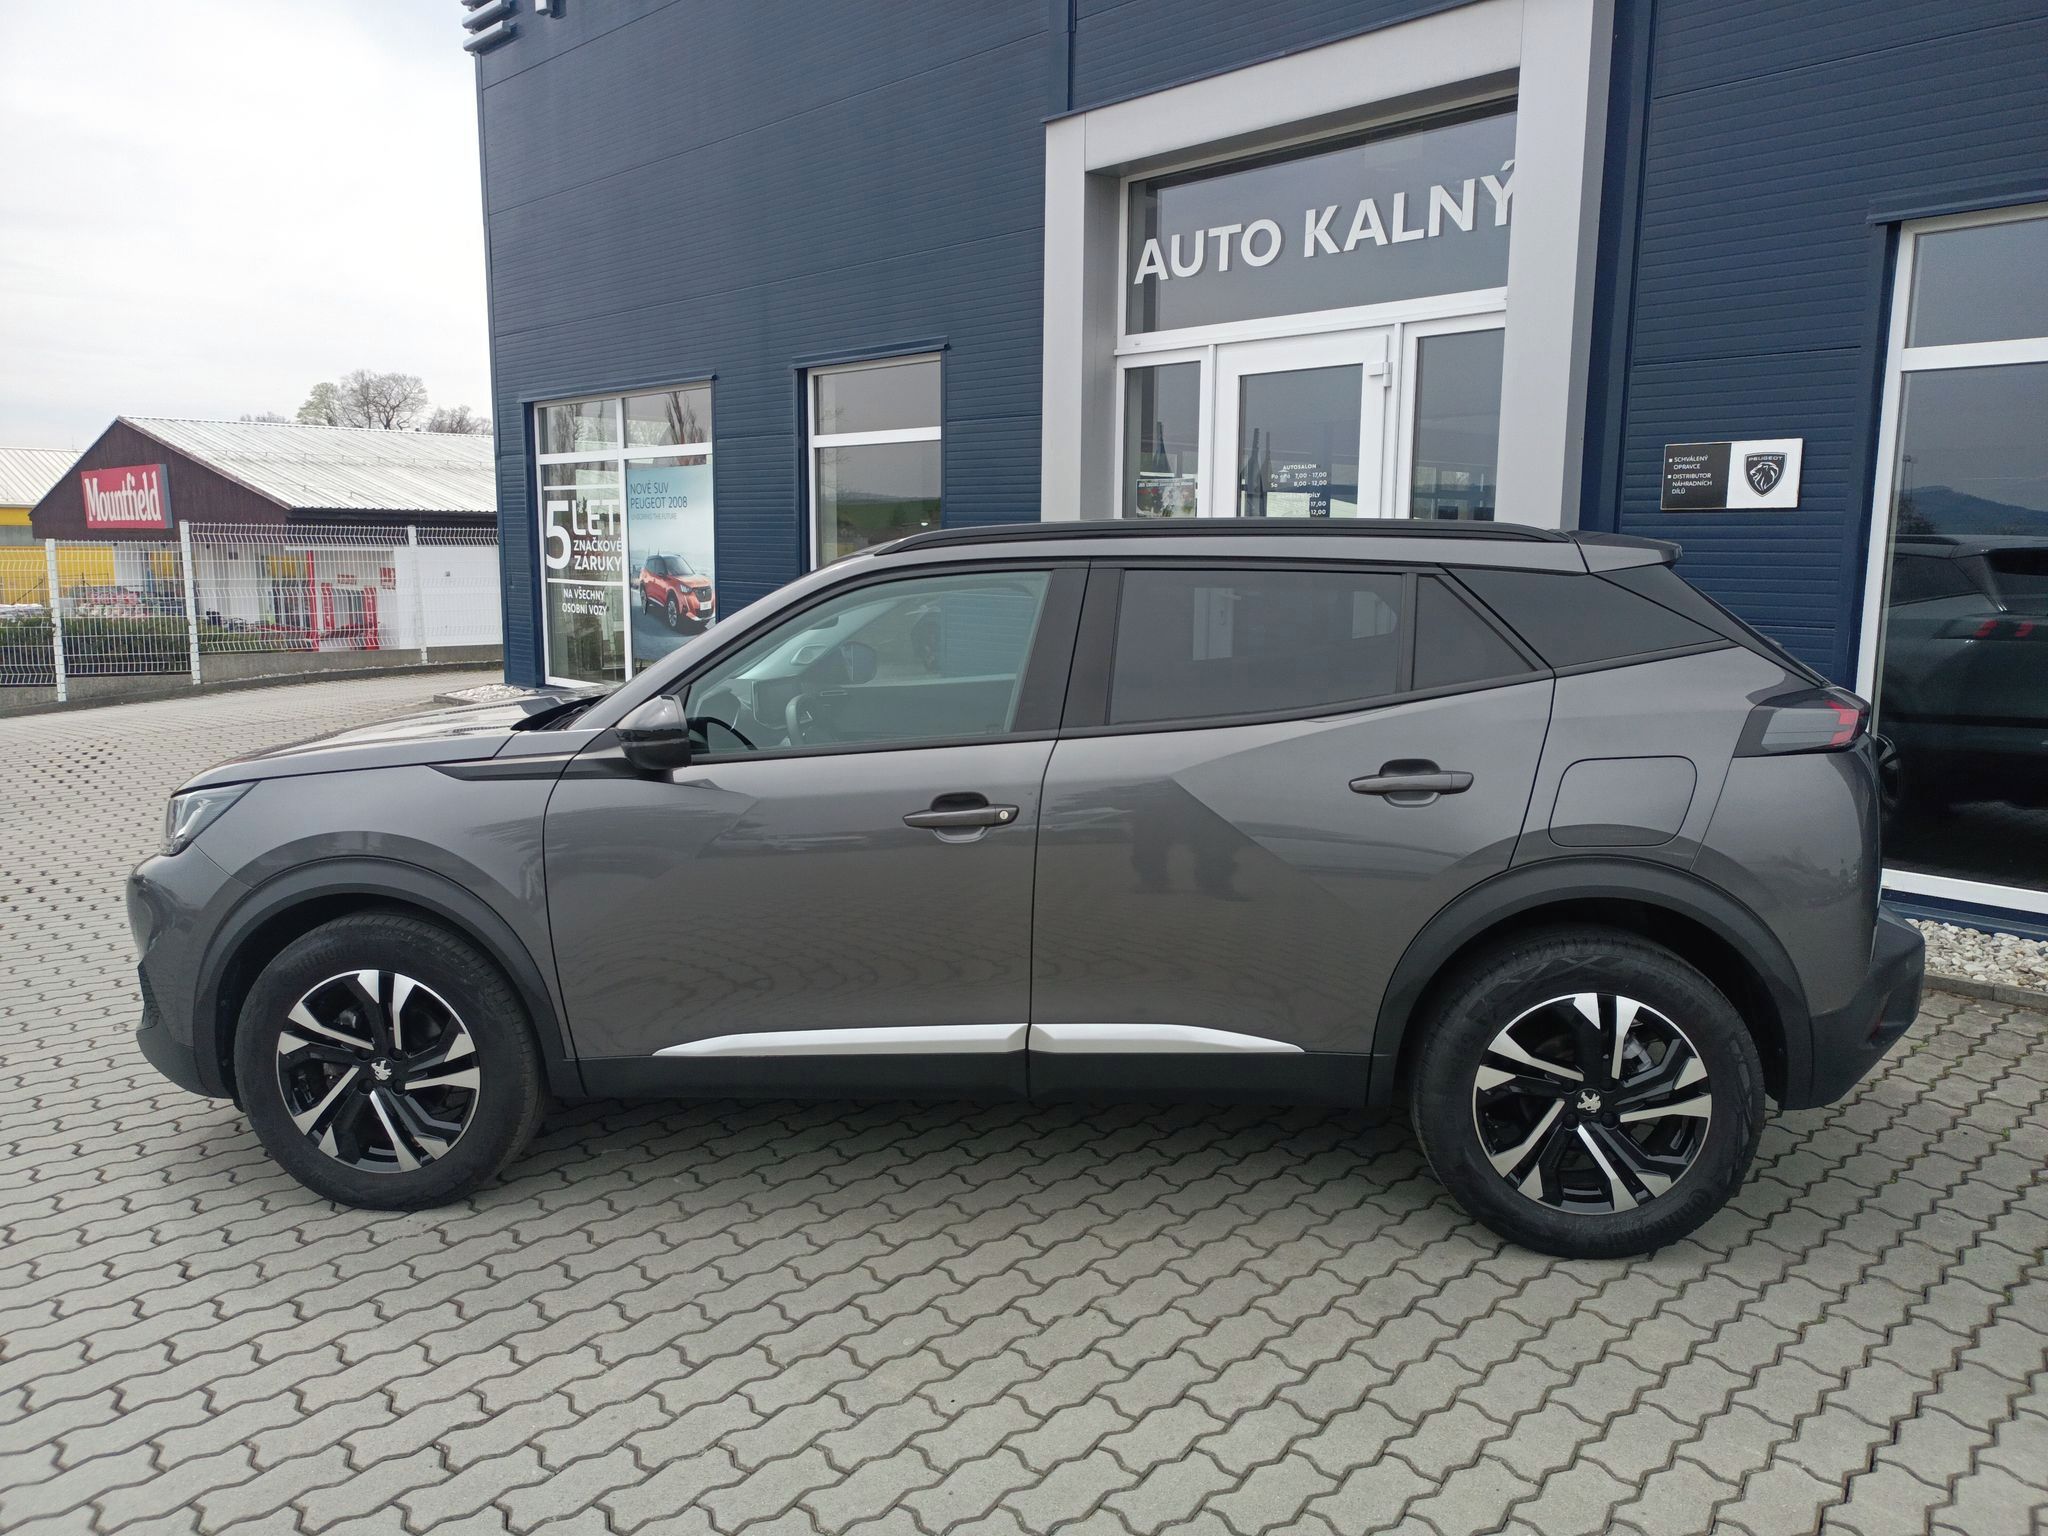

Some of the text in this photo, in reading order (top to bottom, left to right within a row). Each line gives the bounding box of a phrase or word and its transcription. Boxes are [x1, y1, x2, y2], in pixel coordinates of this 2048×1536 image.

[1133, 159, 1516, 284] AUTO KALNÝ
[1673, 454, 1709, 463] SCHVÁLENÝ
[1282, 463, 1317, 471] AUTOSALON
[1671, 479, 1713, 487] NÁHRADNÍCH
[1672, 472, 1712, 480] DISTRIBUTOR
[630, 480, 669, 495] NOVÉ SUV
[84, 470, 162, 522] Mountfield
[630, 495, 688, 509] PEUGEOT 2008
[546, 498, 621, 570] 5 LET
[573, 536, 623, 553] ZNAČKOVÉ
[574, 550, 622, 572] ZÁRUKY
[563, 585, 605, 601] NA VŠECHNY
[561, 601, 608, 616] OSOBNÍ VOZY
